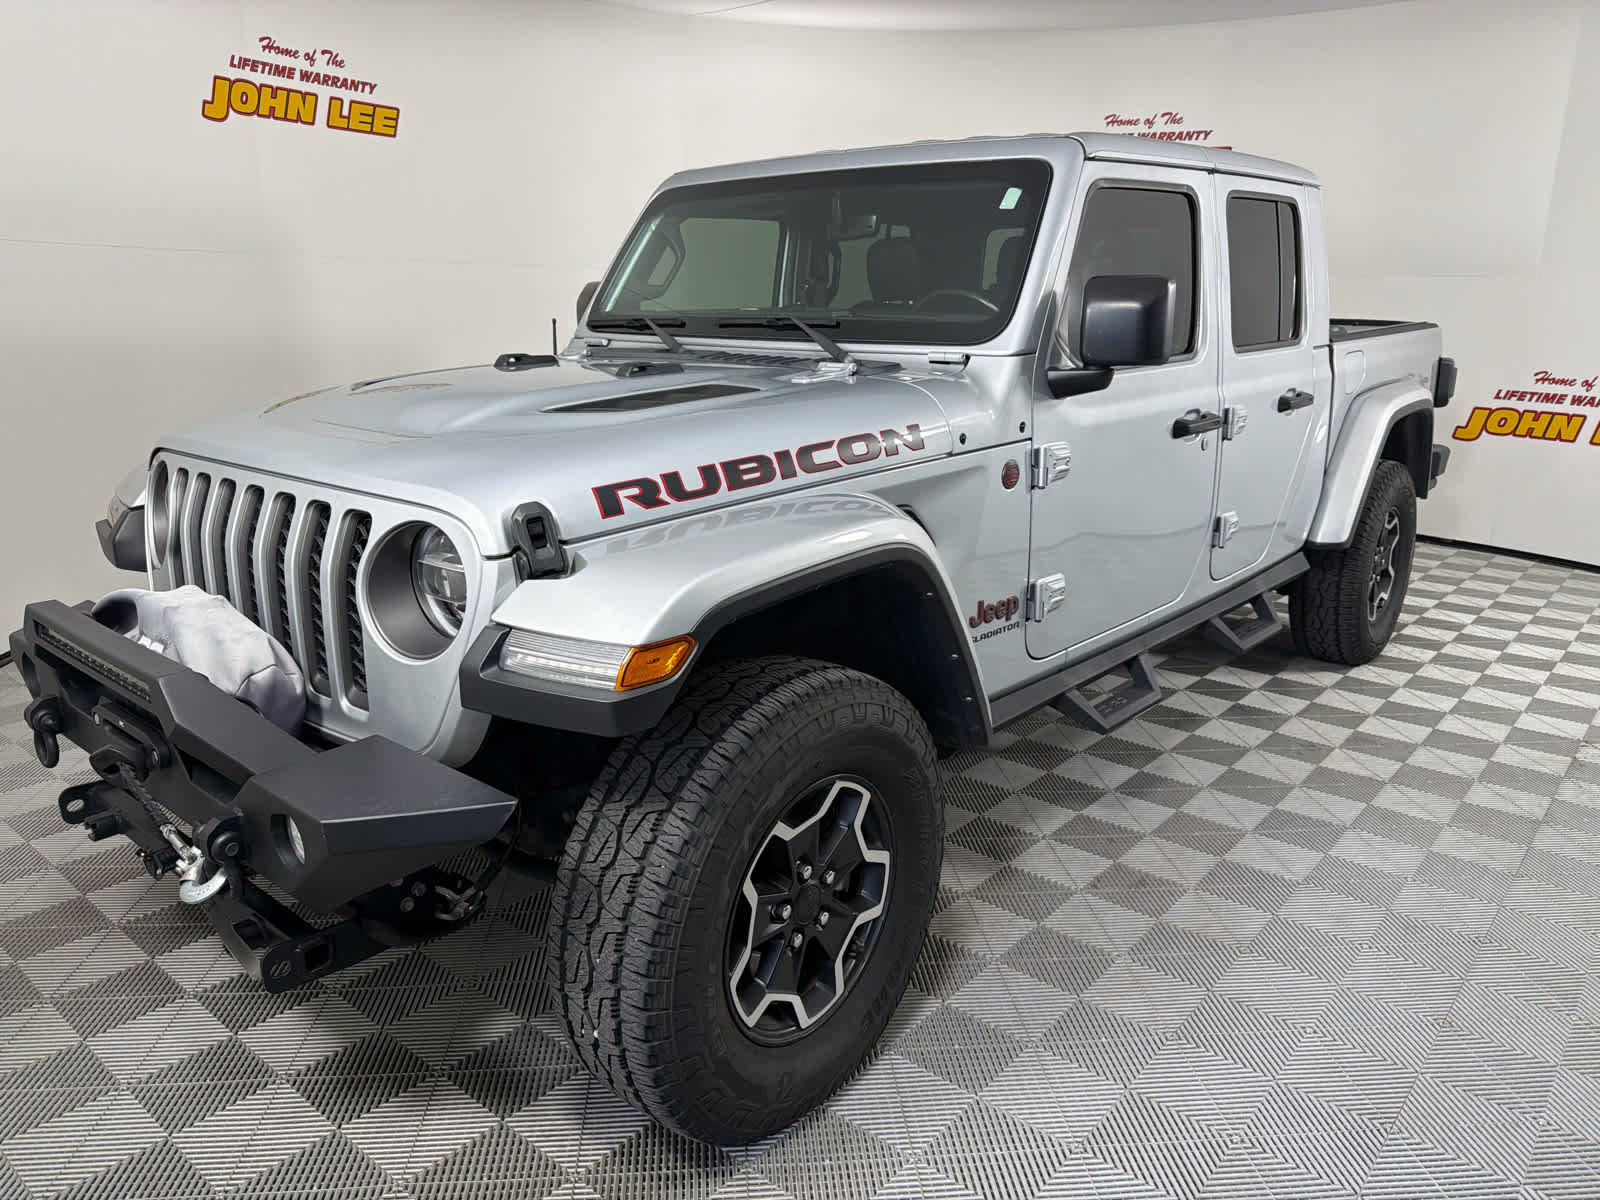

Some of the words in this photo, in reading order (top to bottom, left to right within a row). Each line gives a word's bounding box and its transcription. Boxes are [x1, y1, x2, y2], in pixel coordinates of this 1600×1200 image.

[258, 36, 300, 59] Home
[303, 49, 317, 67] of
[321, 49, 346, 68] The
[229, 54, 297, 80] LIFETIME
[299, 68, 378, 95] WARRANTY
[202, 75, 318, 126] JOHN
[326, 95, 400, 138] LEE
[1104, 113, 1141, 127] Home
[1143, 113, 1158, 129] of
[1161, 111, 1184, 126] The
[1494, 389, 1568, 405] LIFETIME
[1533, 370, 1578, 387] Home
[1581, 376, 1599, 392] of
[1452, 406, 1587, 443] JOHN
[591, 423, 925, 520] RUBICON
[969, 594, 1020, 628] Jeep
